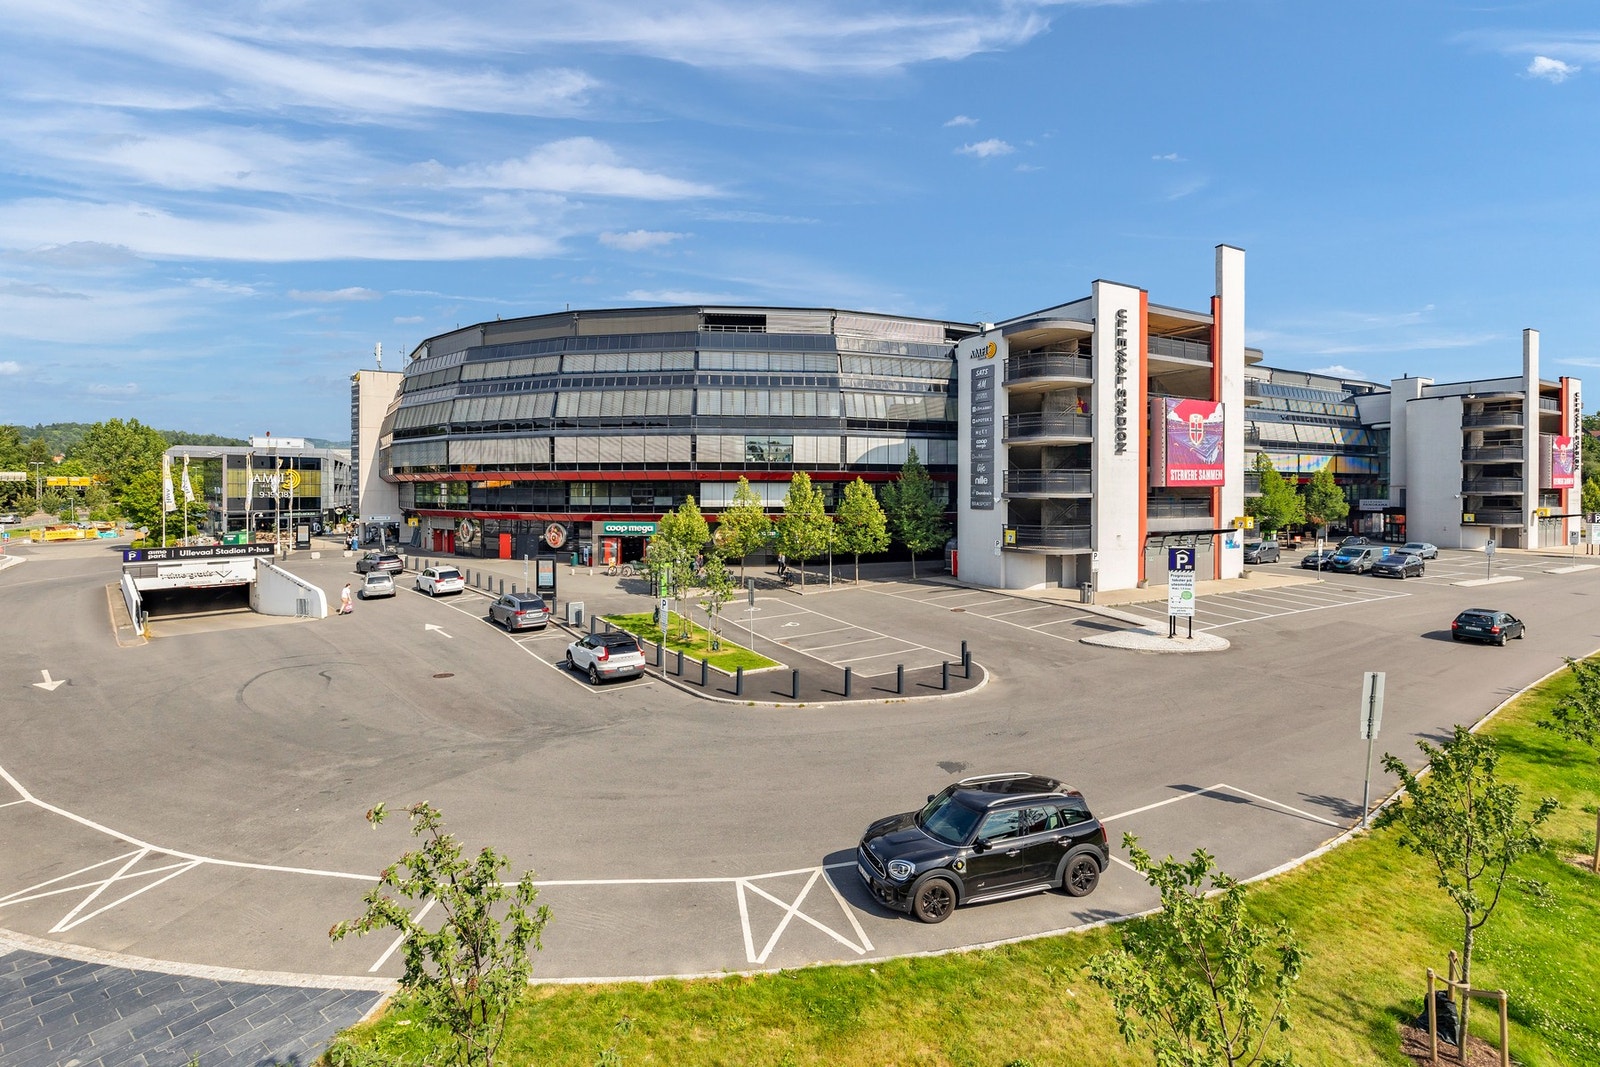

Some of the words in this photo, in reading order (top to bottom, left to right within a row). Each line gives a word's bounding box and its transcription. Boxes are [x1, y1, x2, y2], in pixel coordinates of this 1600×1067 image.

[1114, 308, 1128, 386] ULLEVAAL
[975, 368, 989, 377] SATS
[1114, 387, 1128, 456] STADION
[253, 472, 286, 483] AMI
[975, 475, 988, 485] nille
[1170, 469, 1198, 481] STERKERE
[1198, 469, 1223, 481] SAMMEN
[605, 525, 628, 533] coop
[628, 525, 654, 534] mega
[128, 551, 137, 561] P
[179, 548, 214, 557] Ullevaal
[215, 547, 246, 555] Stadion
[247, 546, 270, 554] P-hus
[1176, 554, 1189, 569] P
